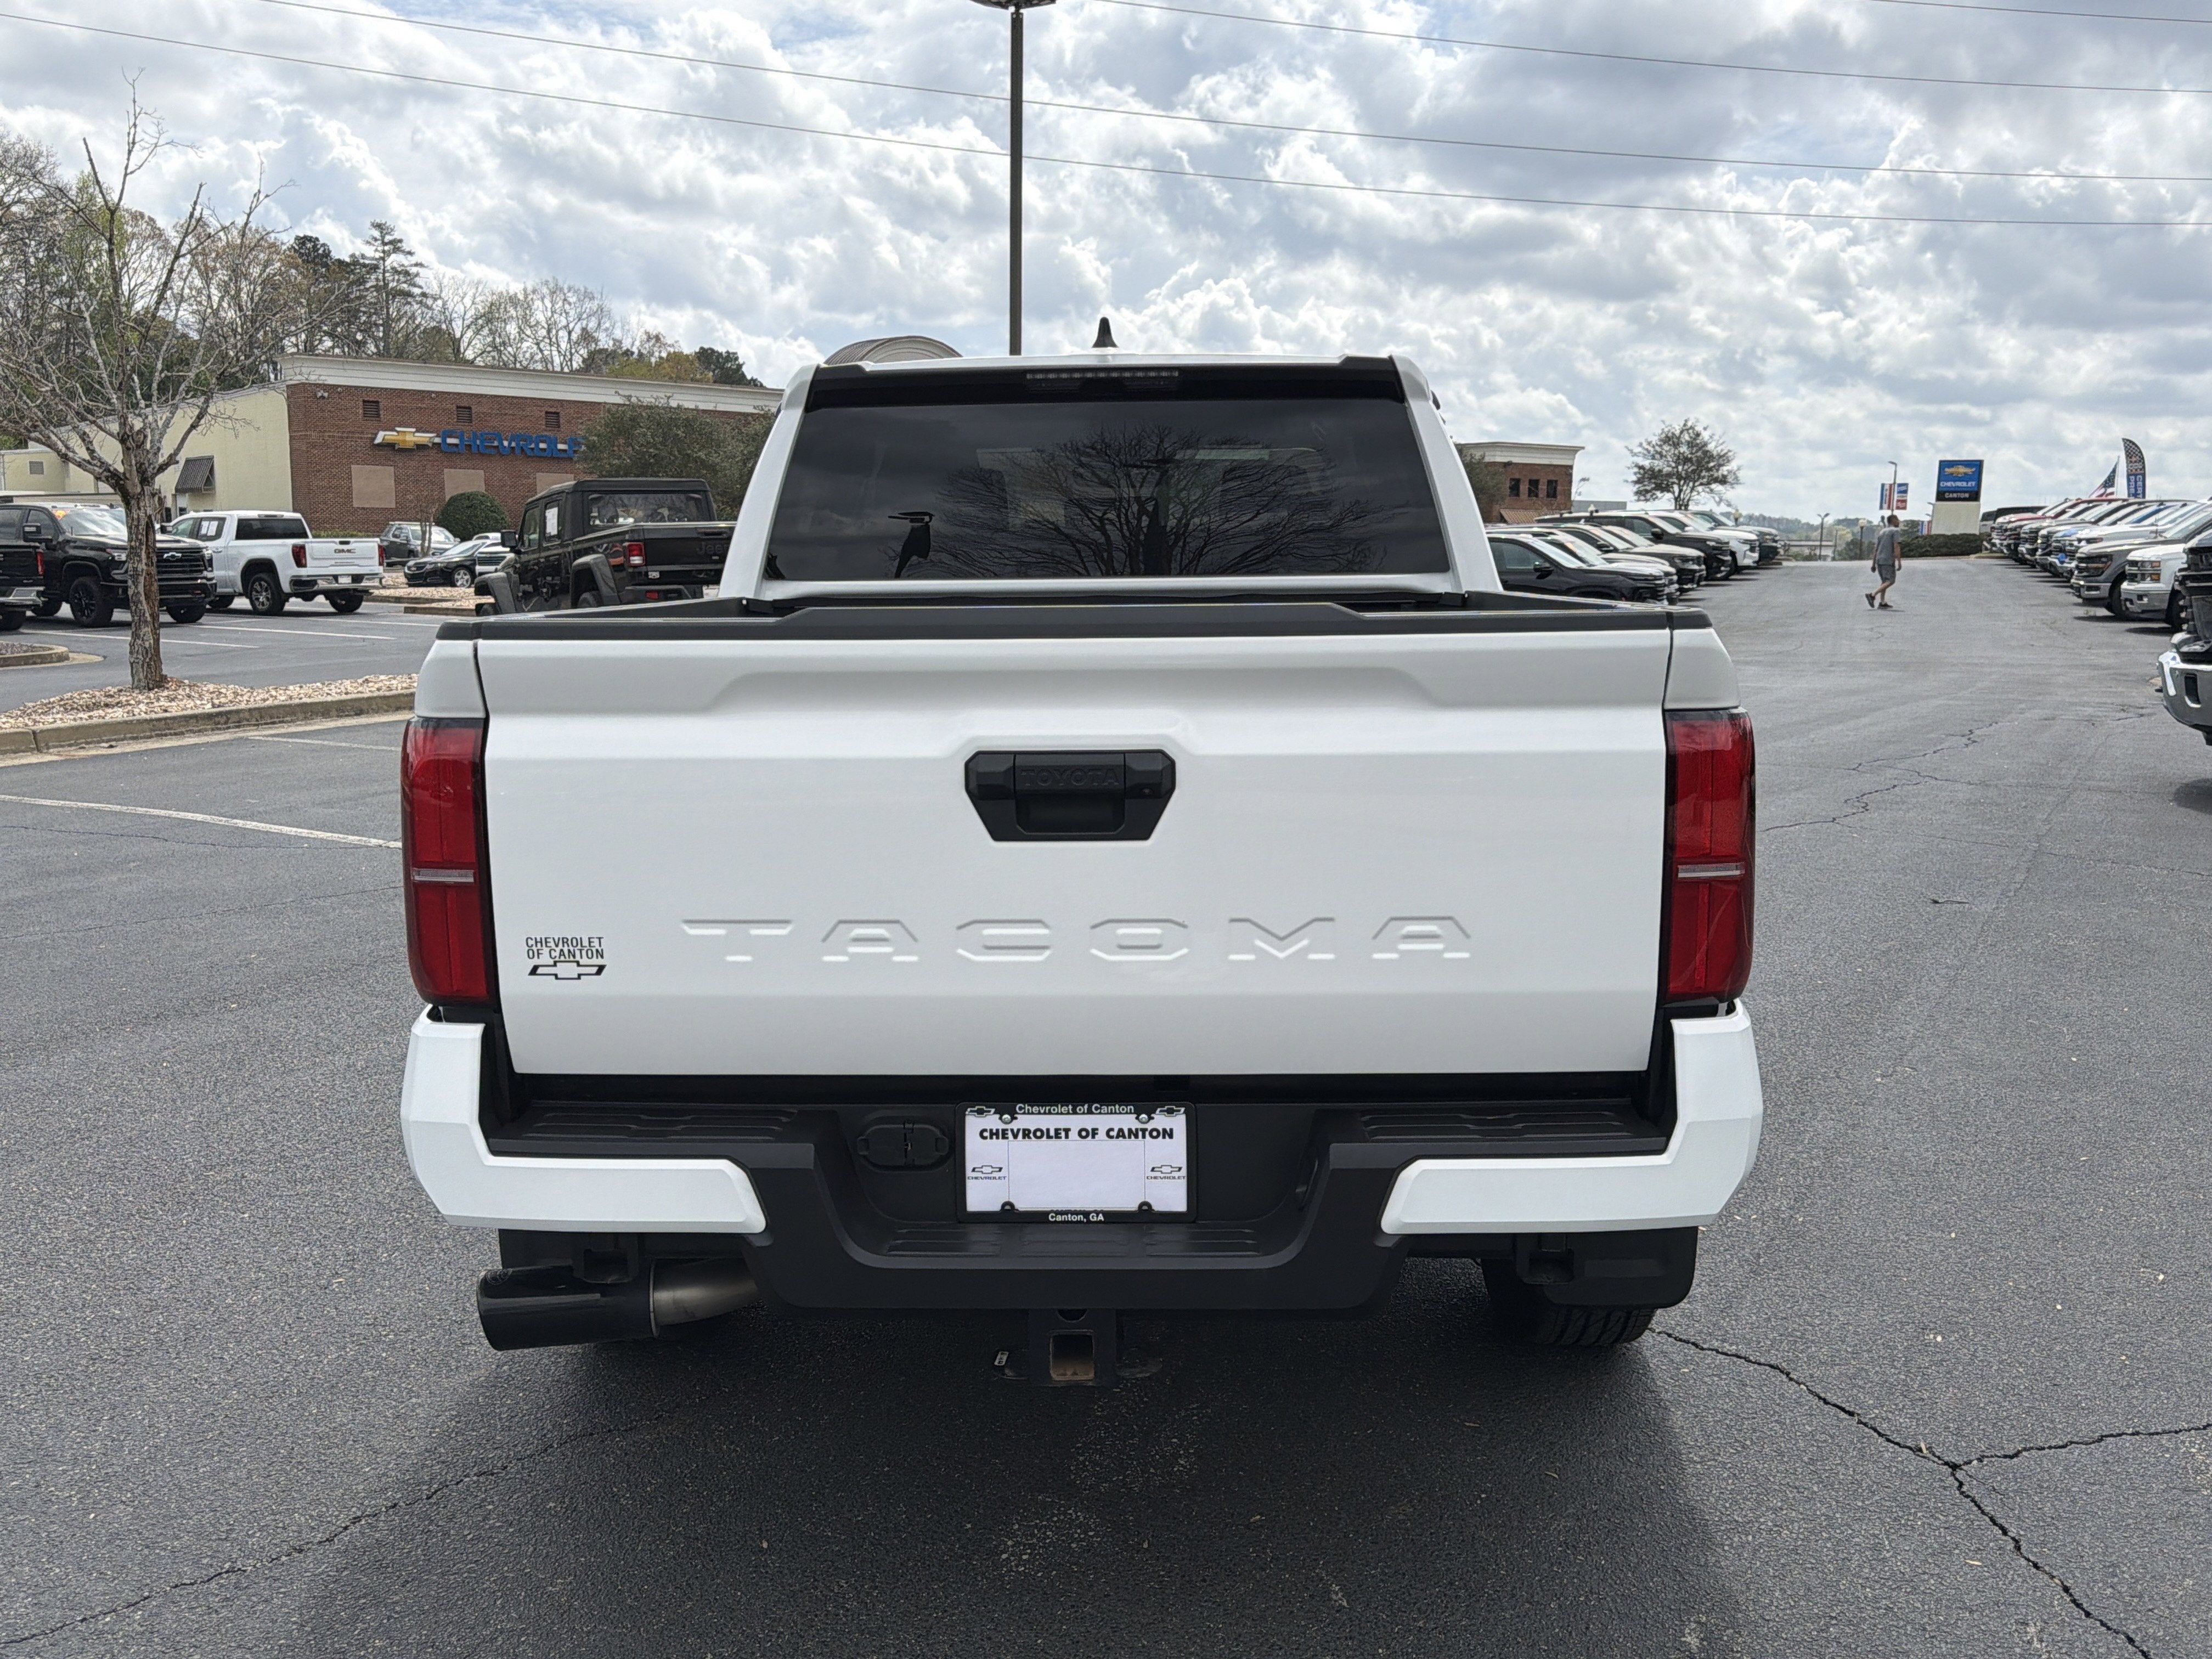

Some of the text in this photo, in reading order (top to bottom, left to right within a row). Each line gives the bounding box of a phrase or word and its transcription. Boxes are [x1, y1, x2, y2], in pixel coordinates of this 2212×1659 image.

[441, 429, 585, 458] CHEVROLE
[1020, 768, 1119, 786] TOYOTA
[526, 936, 604, 948] CHEVROLET
[681, 917, 1471, 961] TACOMA
[527, 948, 605, 960] OF CANTON
[1016, 1104, 1134, 1114] Chevrolet of Canton
[979, 1127, 1174, 1140] CHEVROLET OF CANTON
[1048, 1213, 1104, 1223] Canton, GA
